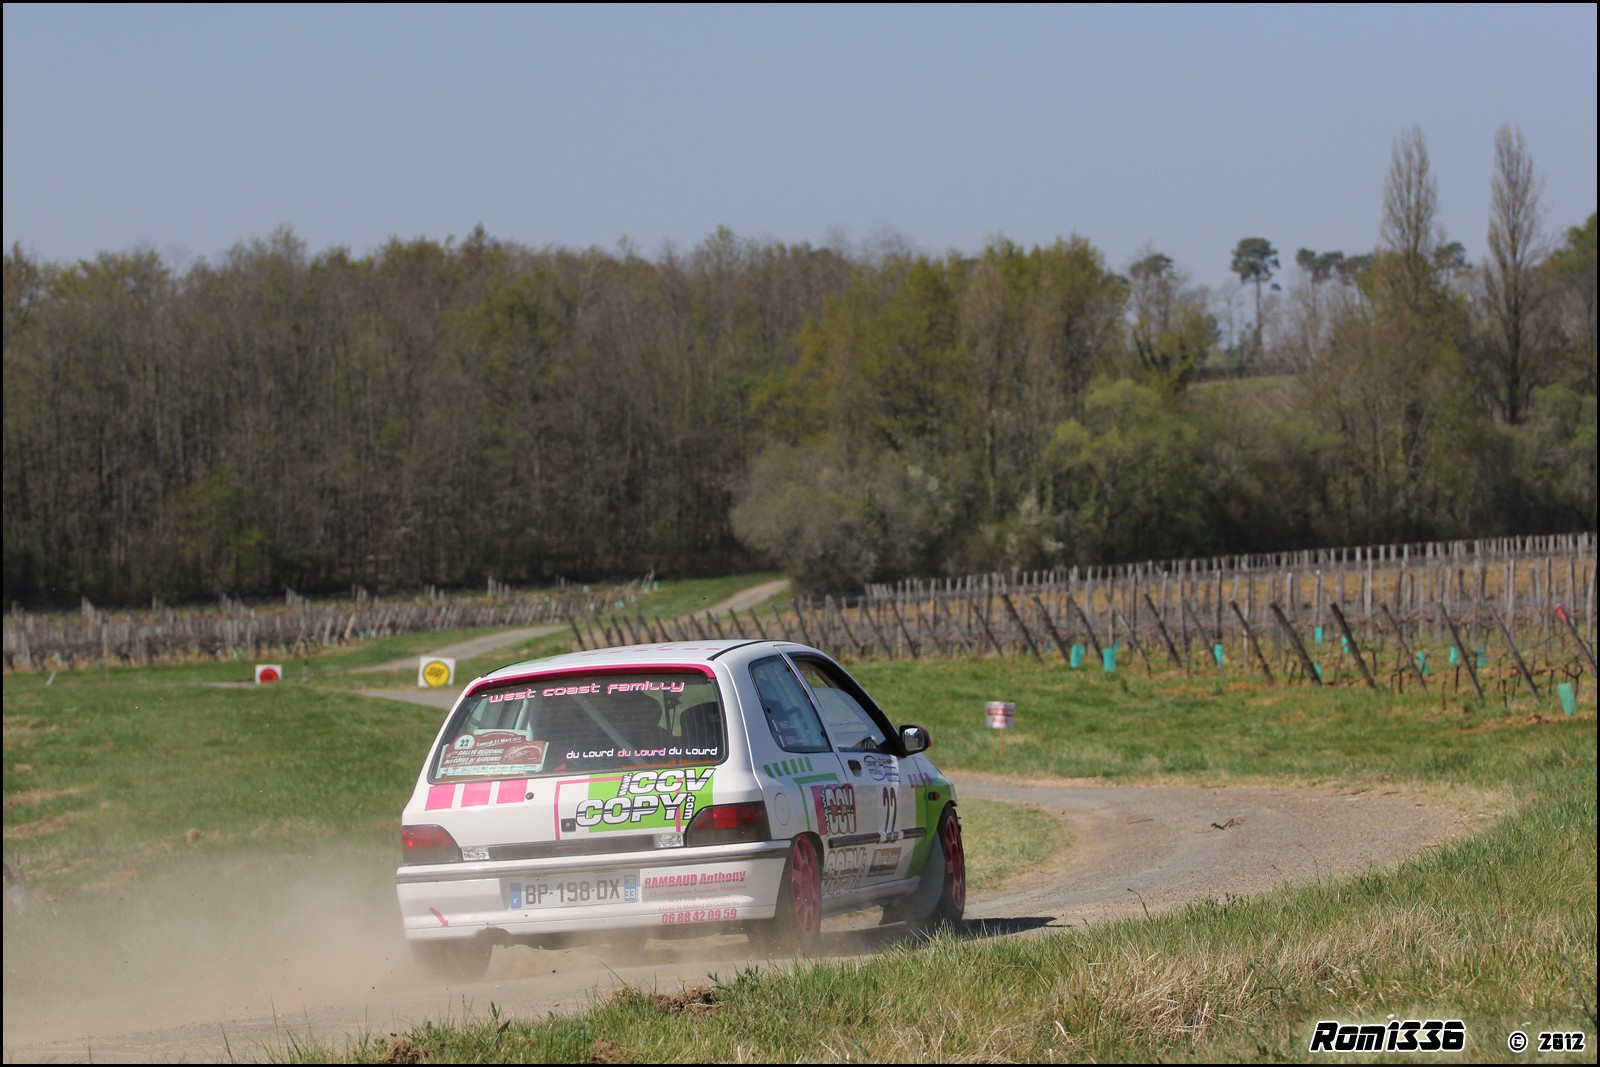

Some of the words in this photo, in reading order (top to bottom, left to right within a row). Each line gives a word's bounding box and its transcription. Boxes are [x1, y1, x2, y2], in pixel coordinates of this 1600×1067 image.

[460, 739, 470, 747] 22
[628, 768, 716, 794] CCV
[575, 793, 687, 827] COPY
[644, 873, 698, 889] RAMBAUD
[699, 871, 746, 885] Anthony
[525, 879, 620, 905] BP-198-DX
[625, 889, 636, 899] 33
[662, 912, 675, 925] 06
[677, 911, 691, 923] 88
[692, 910, 706, 922] 42
[708, 909, 721, 921] 09
[723, 908, 737, 920] 59
